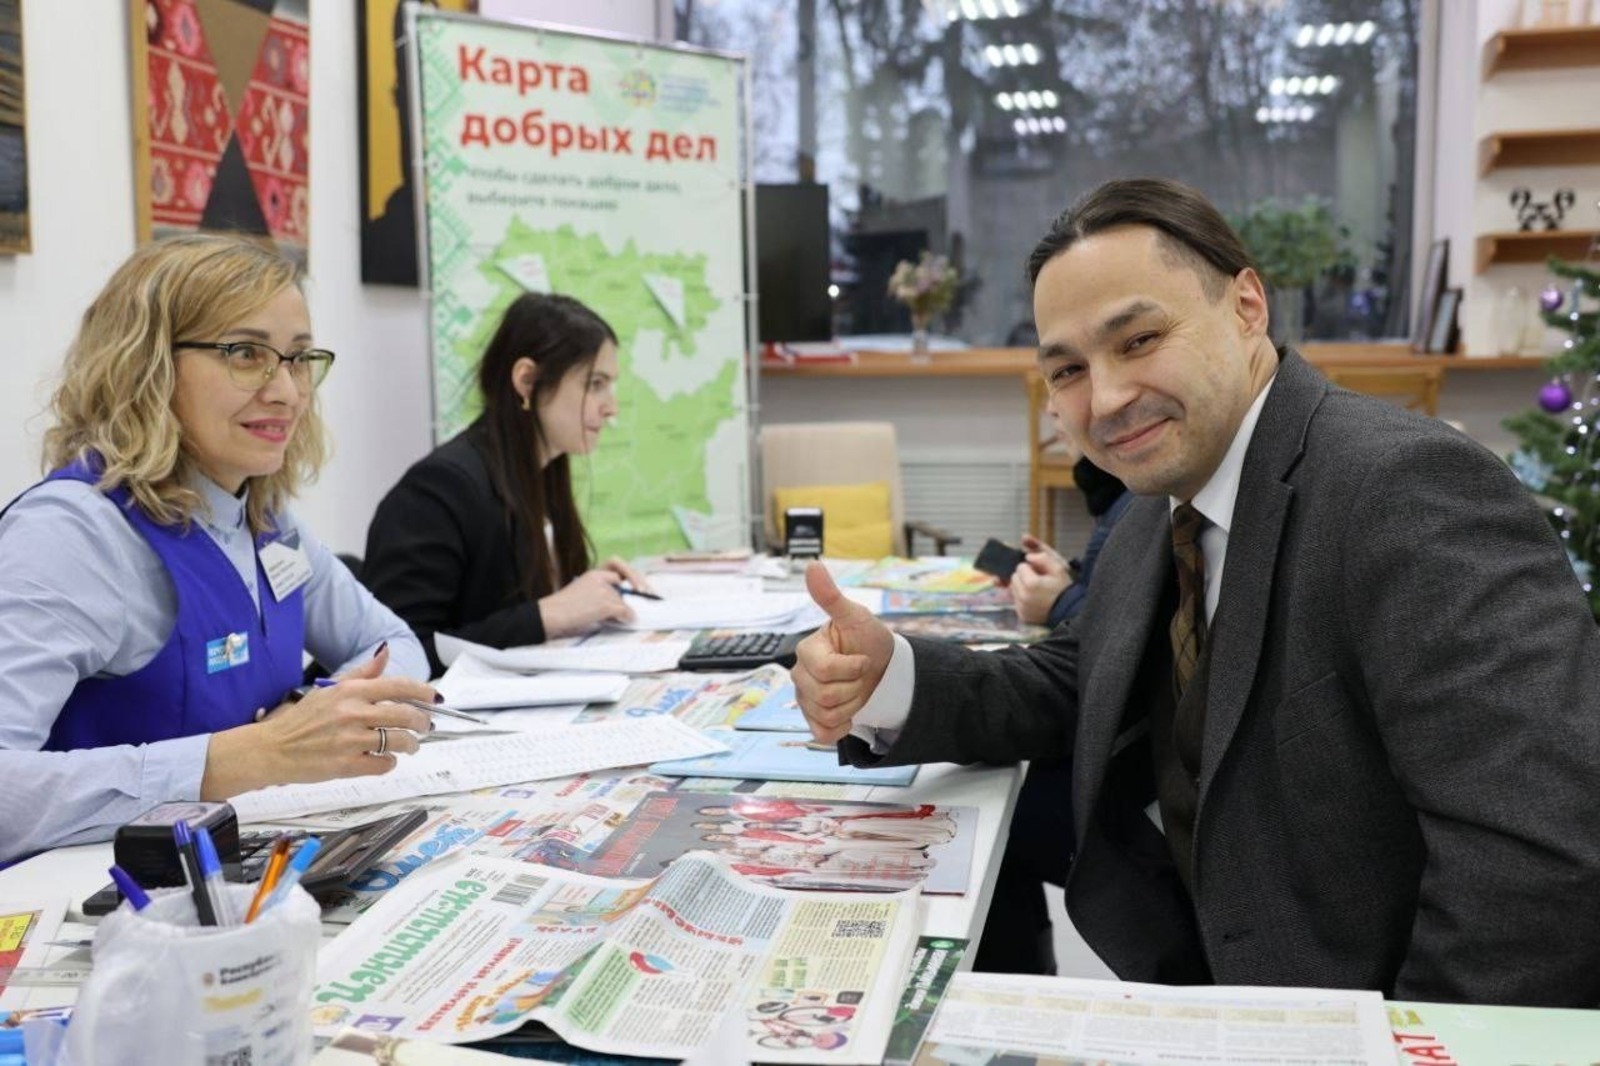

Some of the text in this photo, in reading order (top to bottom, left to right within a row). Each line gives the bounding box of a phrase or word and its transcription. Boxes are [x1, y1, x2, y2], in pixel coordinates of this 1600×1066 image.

[457, 45, 589, 96] Карта
[460, 107, 717, 161] добрых дел
